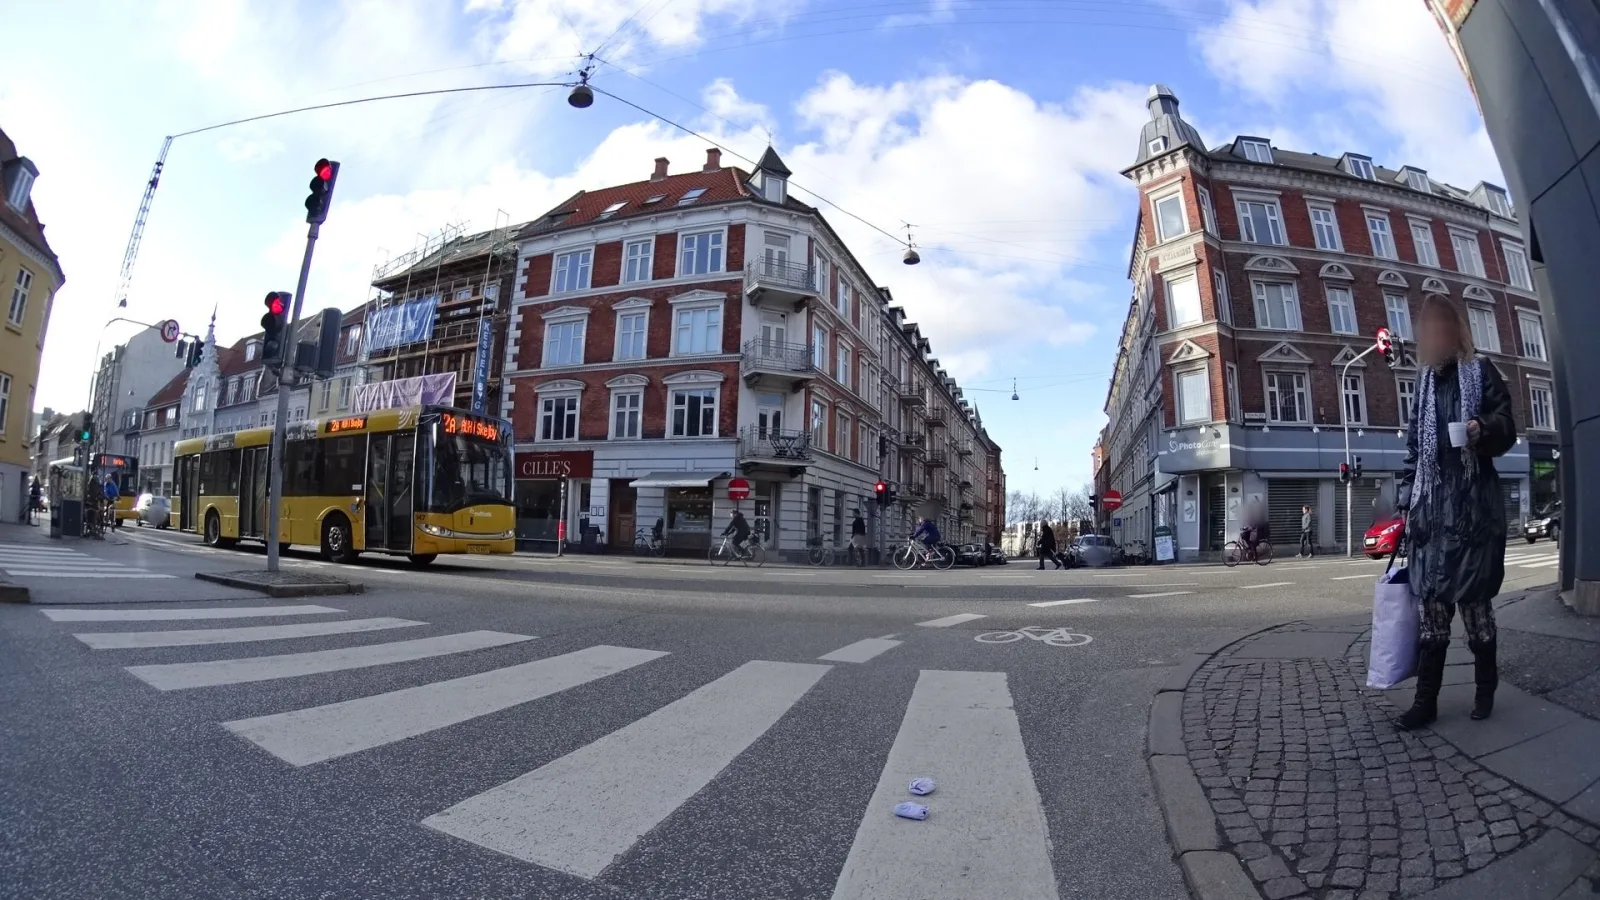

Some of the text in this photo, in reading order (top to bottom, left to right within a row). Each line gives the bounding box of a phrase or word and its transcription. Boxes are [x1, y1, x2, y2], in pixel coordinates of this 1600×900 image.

[474, 321, 491, 409] KESSEL BYG
[443, 413, 456, 434] 2A
[476, 422, 498, 441] Skejby
[522, 460, 571, 475] CILLE'S
